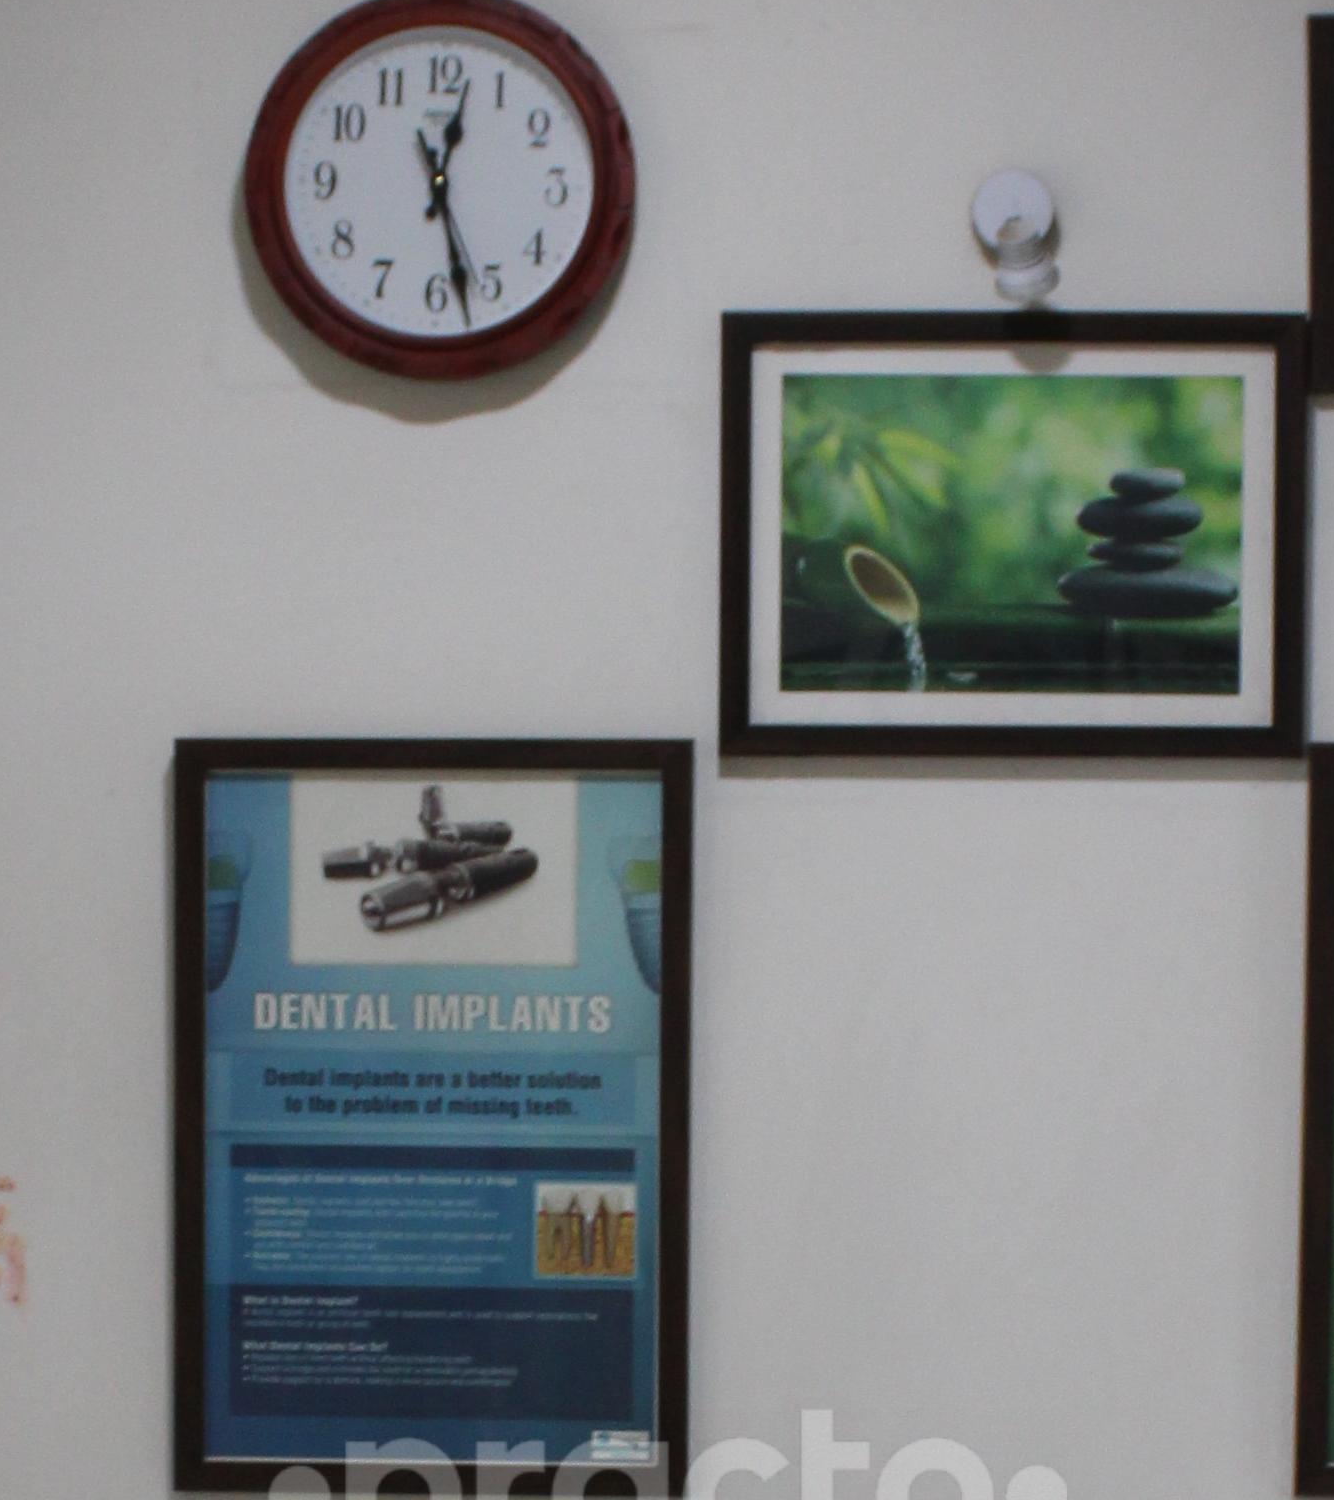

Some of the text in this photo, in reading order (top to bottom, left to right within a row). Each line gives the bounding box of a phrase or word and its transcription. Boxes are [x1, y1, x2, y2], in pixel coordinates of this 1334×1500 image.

[378, 67, 405, 107] 11
[427, 54, 463, 95] 12
[494, 71, 506, 109] 1
[332, 103, 367, 143] 10
[528, 108, 551, 148] 2
[313, 161, 337, 200] 9
[545, 167, 568, 206] 3
[331, 219, 354, 260] 8
[522, 228, 545, 266] 4
[371, 258, 395, 299] 7
[425, 273, 448, 313] 6
[479, 263, 502, 301] 5
[253, 991, 612, 1034] DENTAL IMPLANTS
[264, 1067, 324, 1087] Dental
[415, 1073, 446, 1088] are
[451, 1073, 462, 1089] a
[467, 1070, 522, 1089] better
[284, 1094, 303, 1113] to
[308, 1094, 337, 1113] the
[425, 1095, 443, 1114] of
